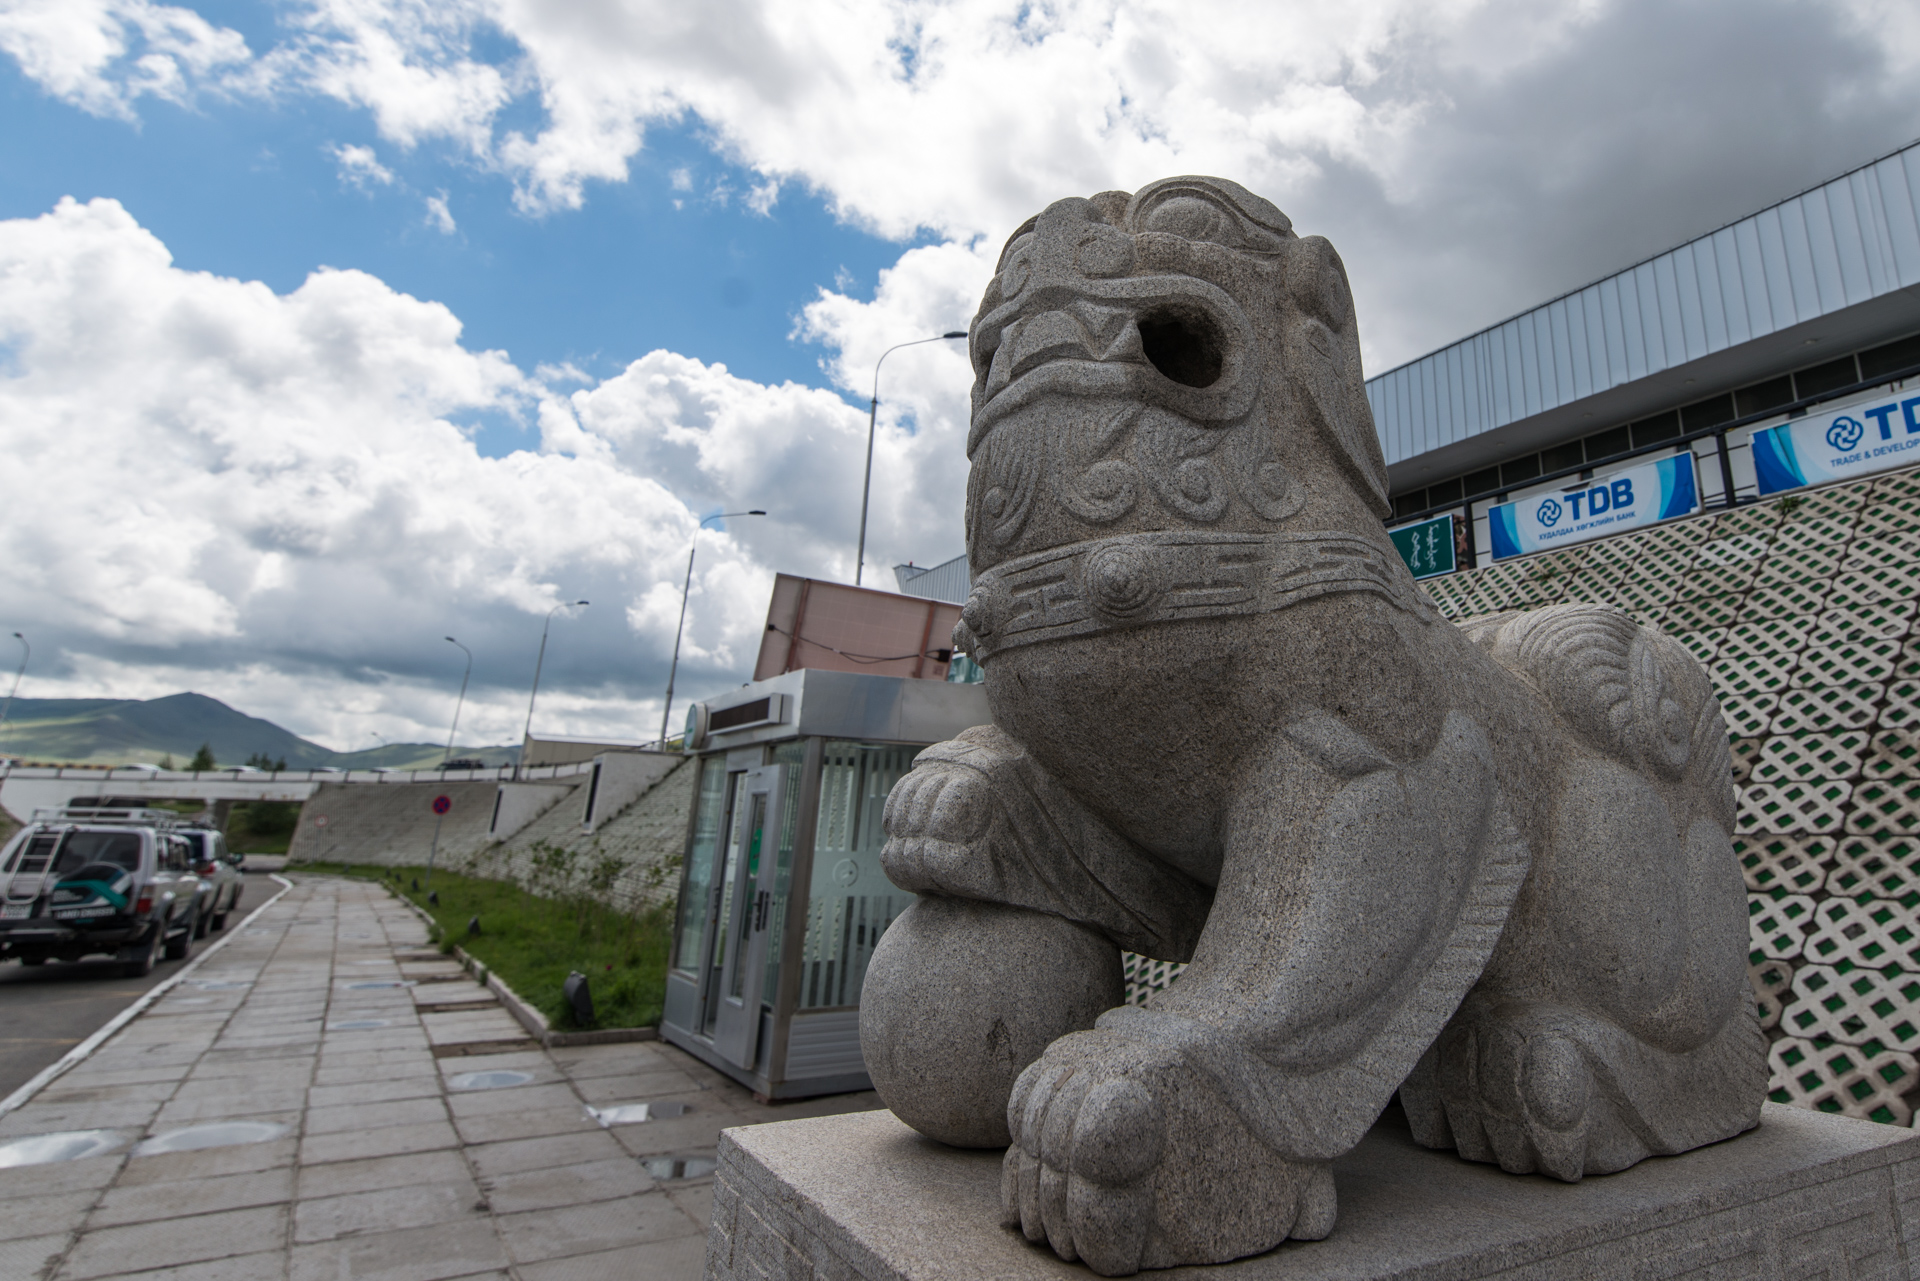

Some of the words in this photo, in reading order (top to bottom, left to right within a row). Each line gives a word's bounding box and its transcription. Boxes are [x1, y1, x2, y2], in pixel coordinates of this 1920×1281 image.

[1830, 452, 1862, 467] TRADE
[1864, 451, 1871, 459] &
[1563, 478, 1634, 521] TDB
[1538, 527, 1574, 541] ХУДАЛДАА
[1576, 515, 1615, 532] ХӨГЖЛИЙН
[1616, 511, 1636, 522] БАНК
